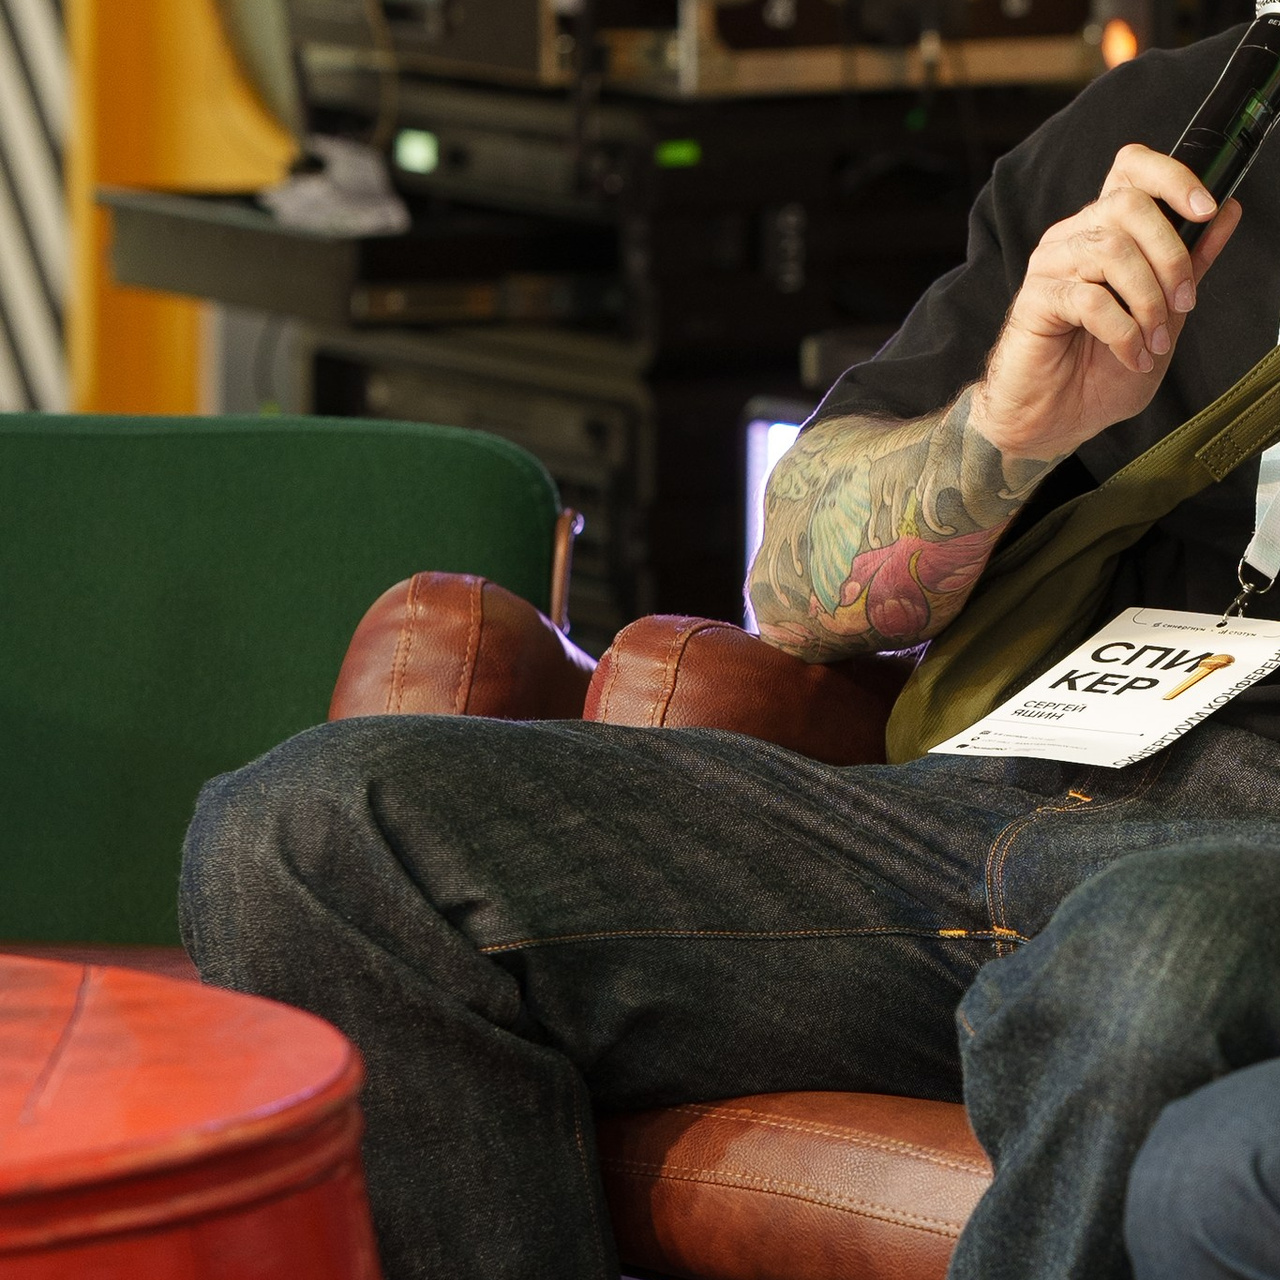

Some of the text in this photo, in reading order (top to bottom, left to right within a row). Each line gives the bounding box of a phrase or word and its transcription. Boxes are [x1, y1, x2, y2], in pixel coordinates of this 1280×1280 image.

[1091, 641, 1215, 674] СПИ
[1049, 669, 1160, 696] КЕР
[1011, 709, 1064, 720] ЯШИН
[1023, 700, 1087, 713] СЕРГЕЙ
[1113, 711, 1210, 768] СИНЕРГИУМ
